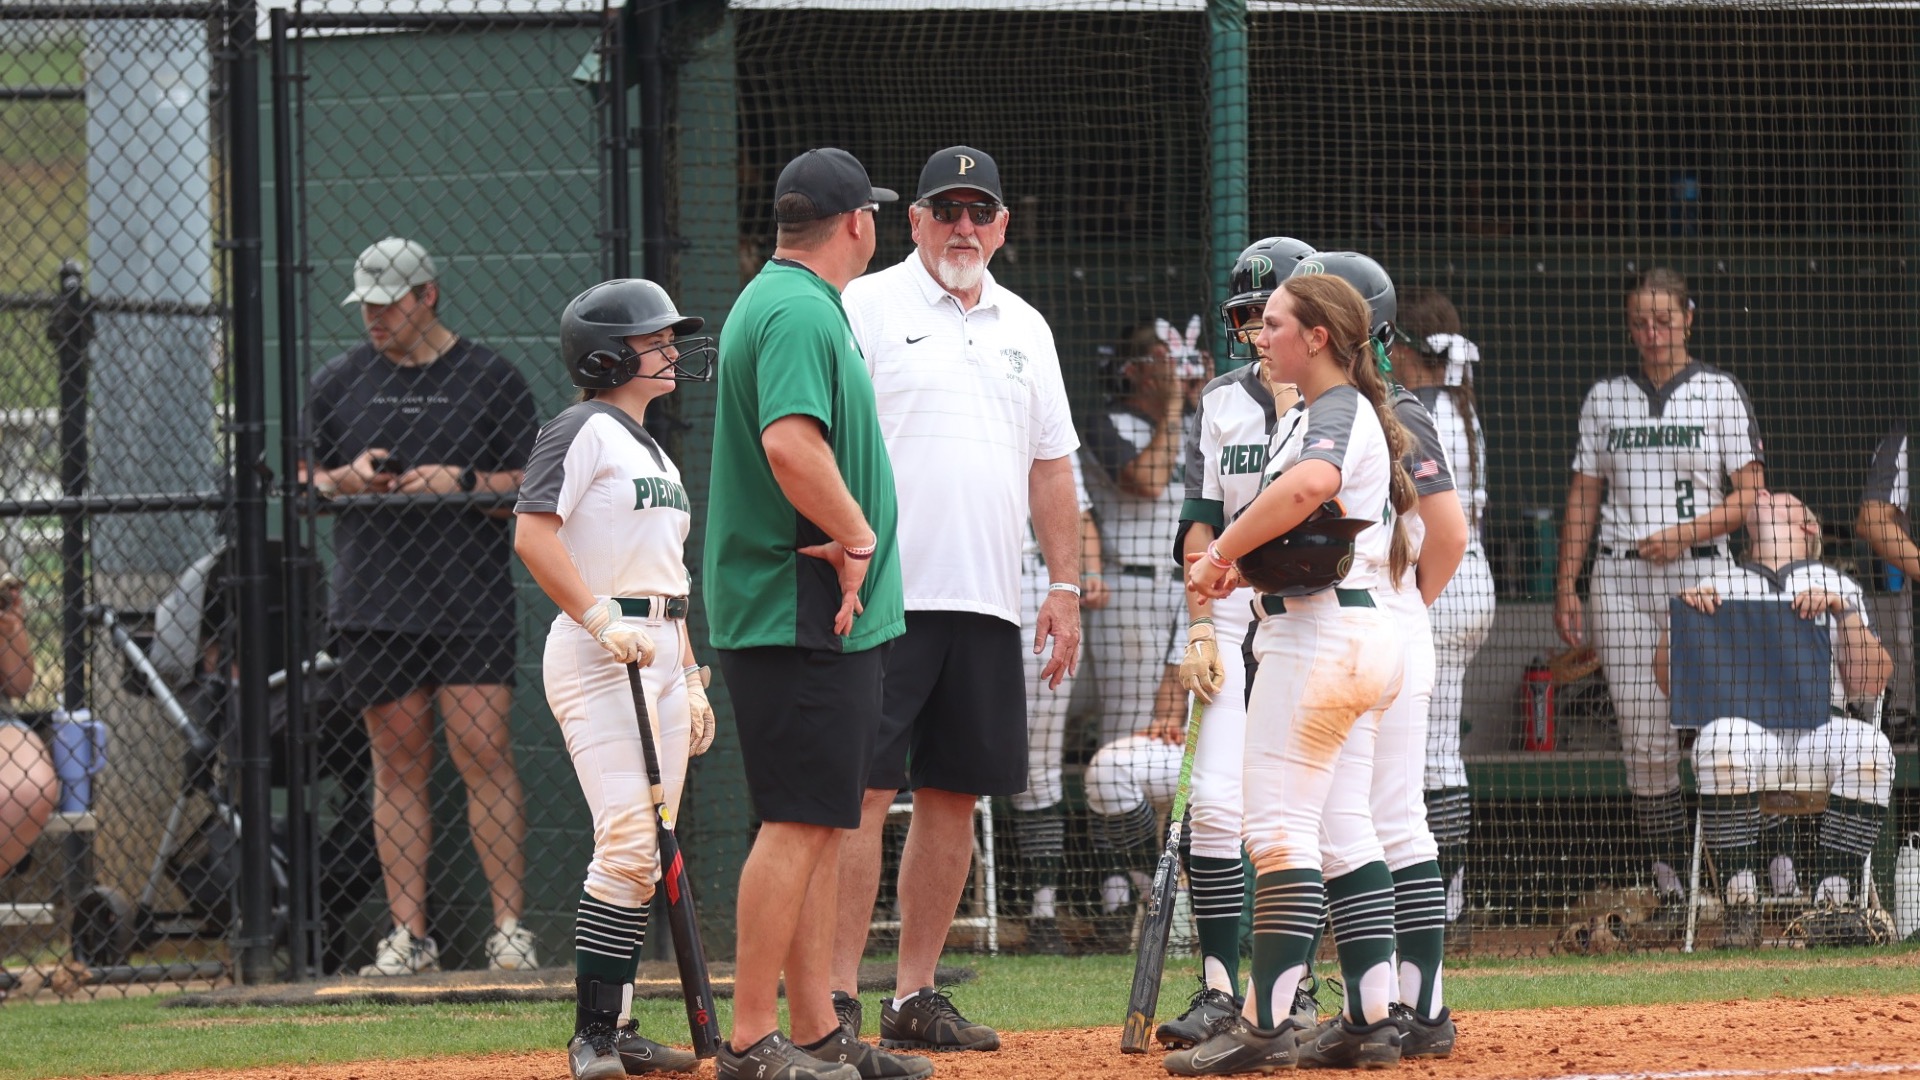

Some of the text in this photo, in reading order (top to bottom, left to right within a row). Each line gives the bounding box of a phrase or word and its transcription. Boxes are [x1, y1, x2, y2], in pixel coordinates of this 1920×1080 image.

[954, 154, 975, 175] P
[1246, 255, 1273, 289] P
[1606, 425, 1706, 451] PIEDMONT
[1220, 444, 1268, 476] PIED
[1675, 480, 1696, 519] 2
